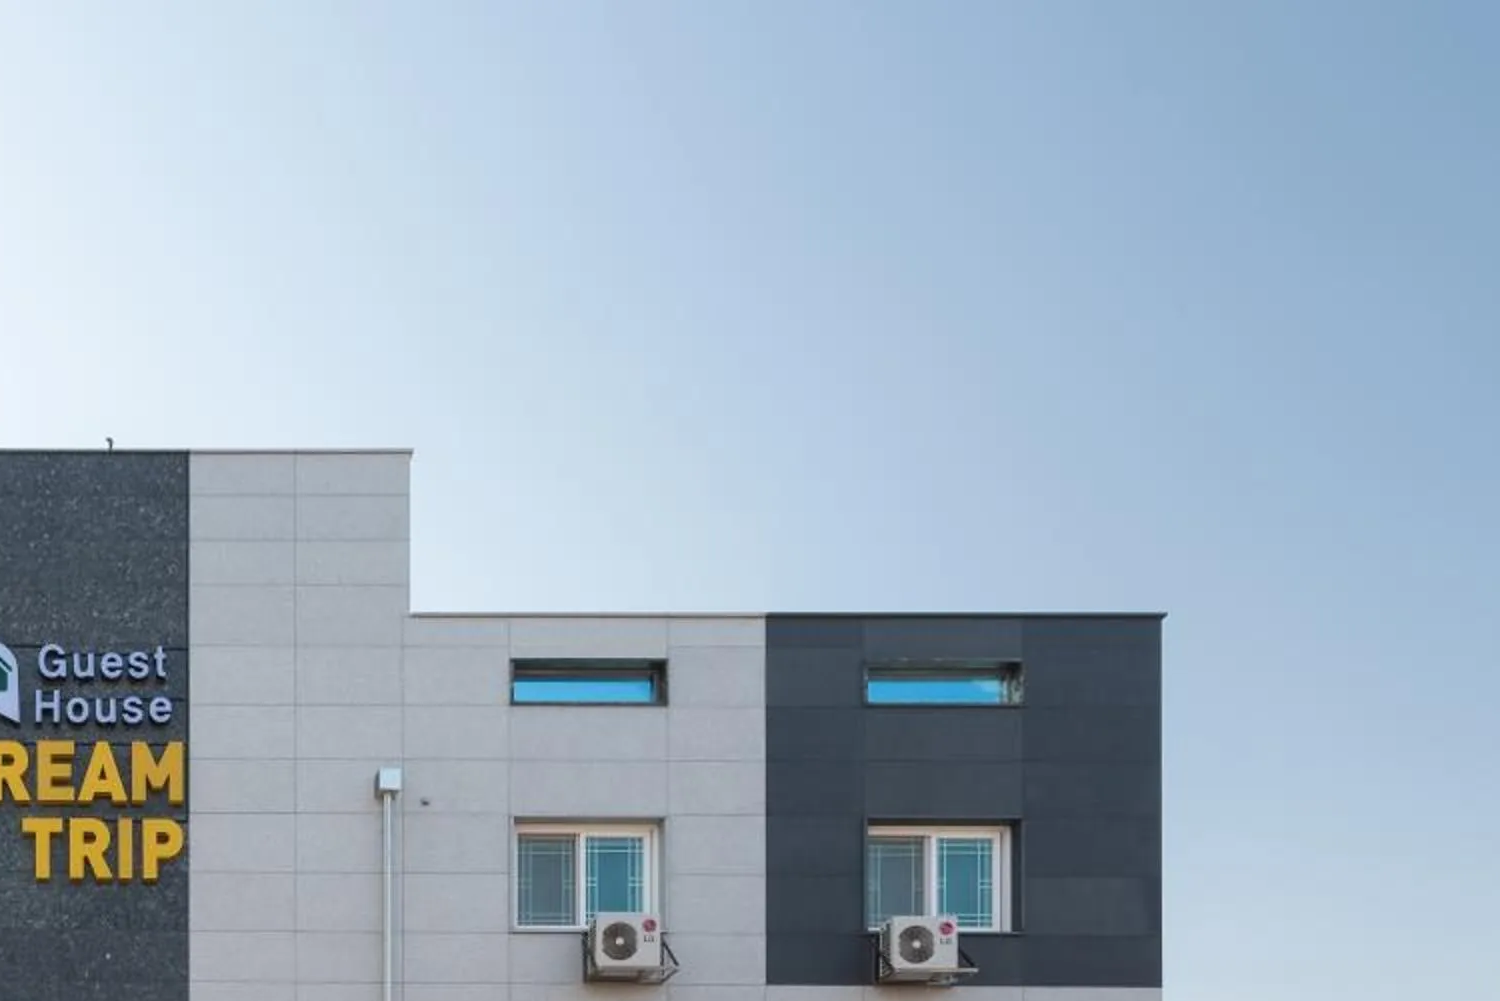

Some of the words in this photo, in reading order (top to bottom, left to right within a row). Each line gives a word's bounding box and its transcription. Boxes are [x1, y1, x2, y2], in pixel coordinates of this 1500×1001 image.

[38, 644, 167, 680] Guest
[35, 689, 173, 724] House
[21, 817, 184, 882] TRIP
